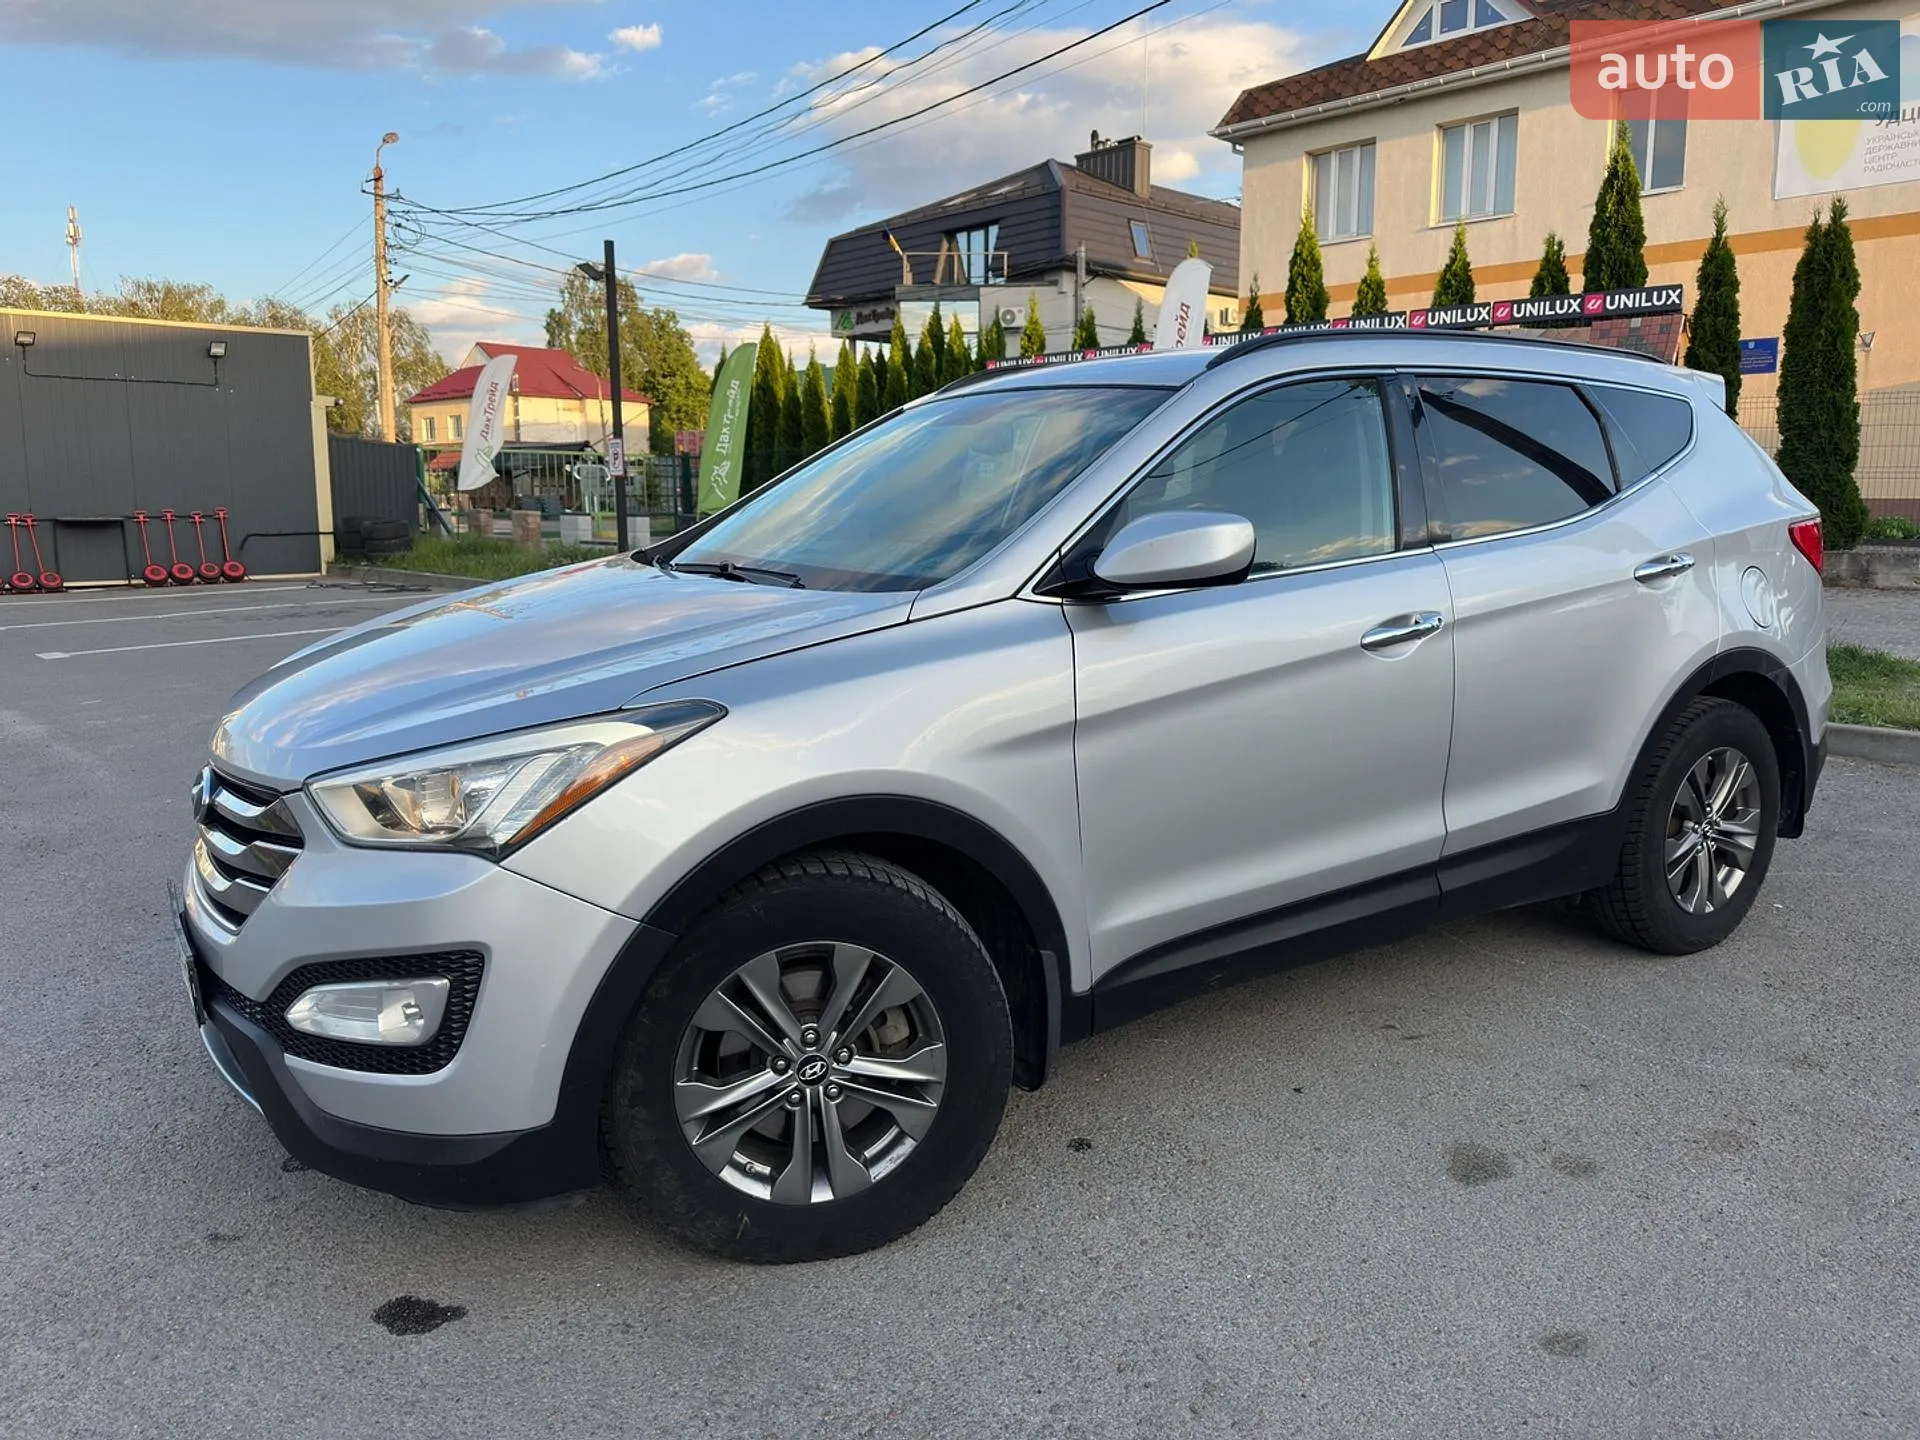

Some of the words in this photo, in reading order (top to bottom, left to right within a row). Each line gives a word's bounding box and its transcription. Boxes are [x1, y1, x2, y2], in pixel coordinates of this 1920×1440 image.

[1513, 298, 1581, 318] UNILUX
[1605, 288, 1682, 310] UNILUX
[1427, 305, 1490, 326] UNILUX
